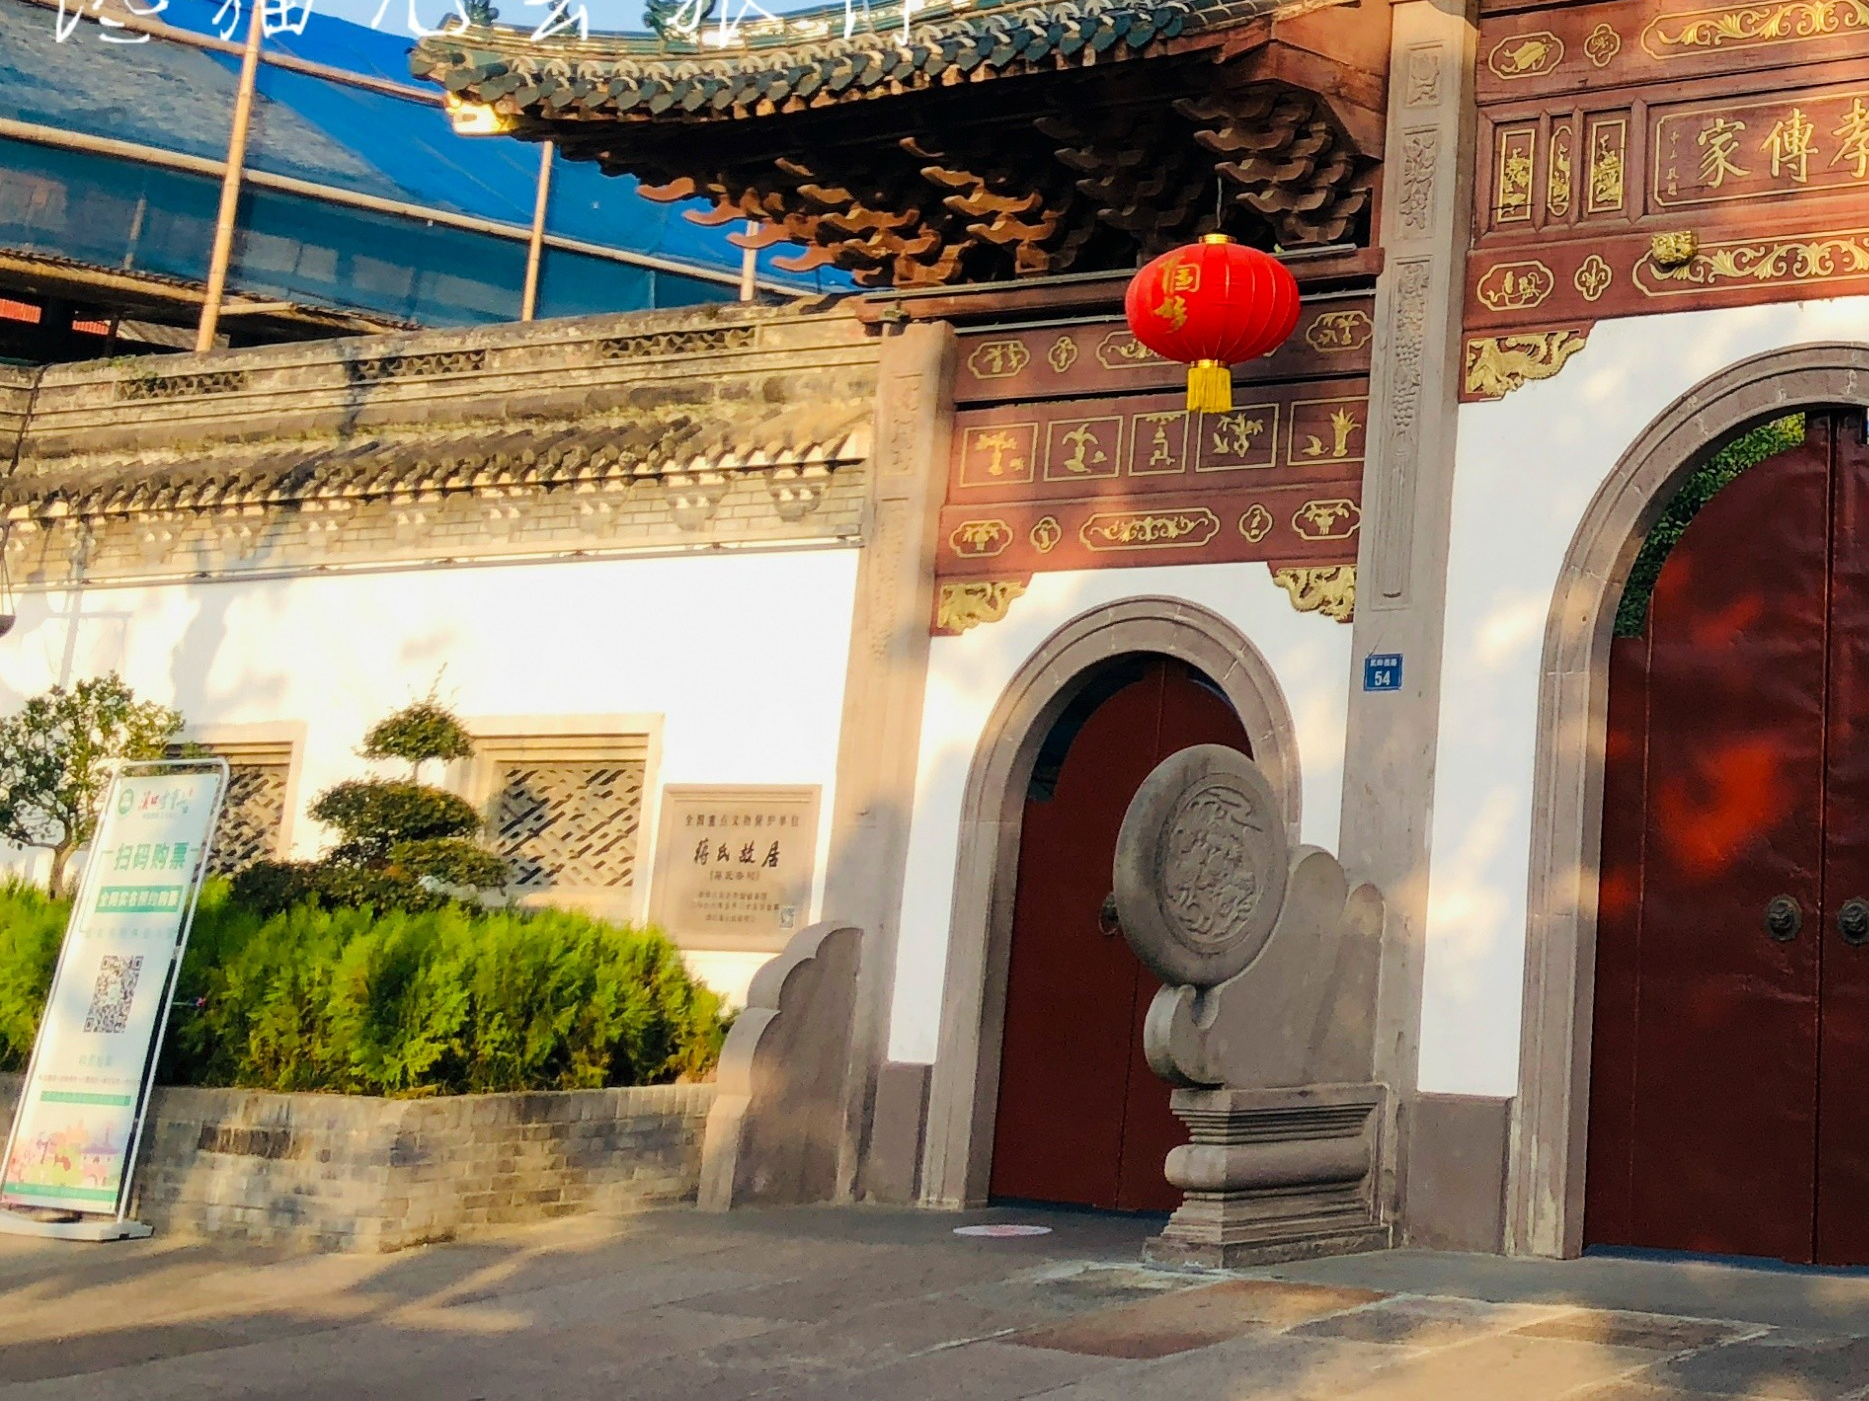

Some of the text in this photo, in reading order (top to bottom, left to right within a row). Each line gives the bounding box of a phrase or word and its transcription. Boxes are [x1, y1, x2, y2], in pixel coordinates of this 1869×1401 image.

[1374, 670, 1391, 686] 54
[114, 841, 190, 870] 扫码购票
